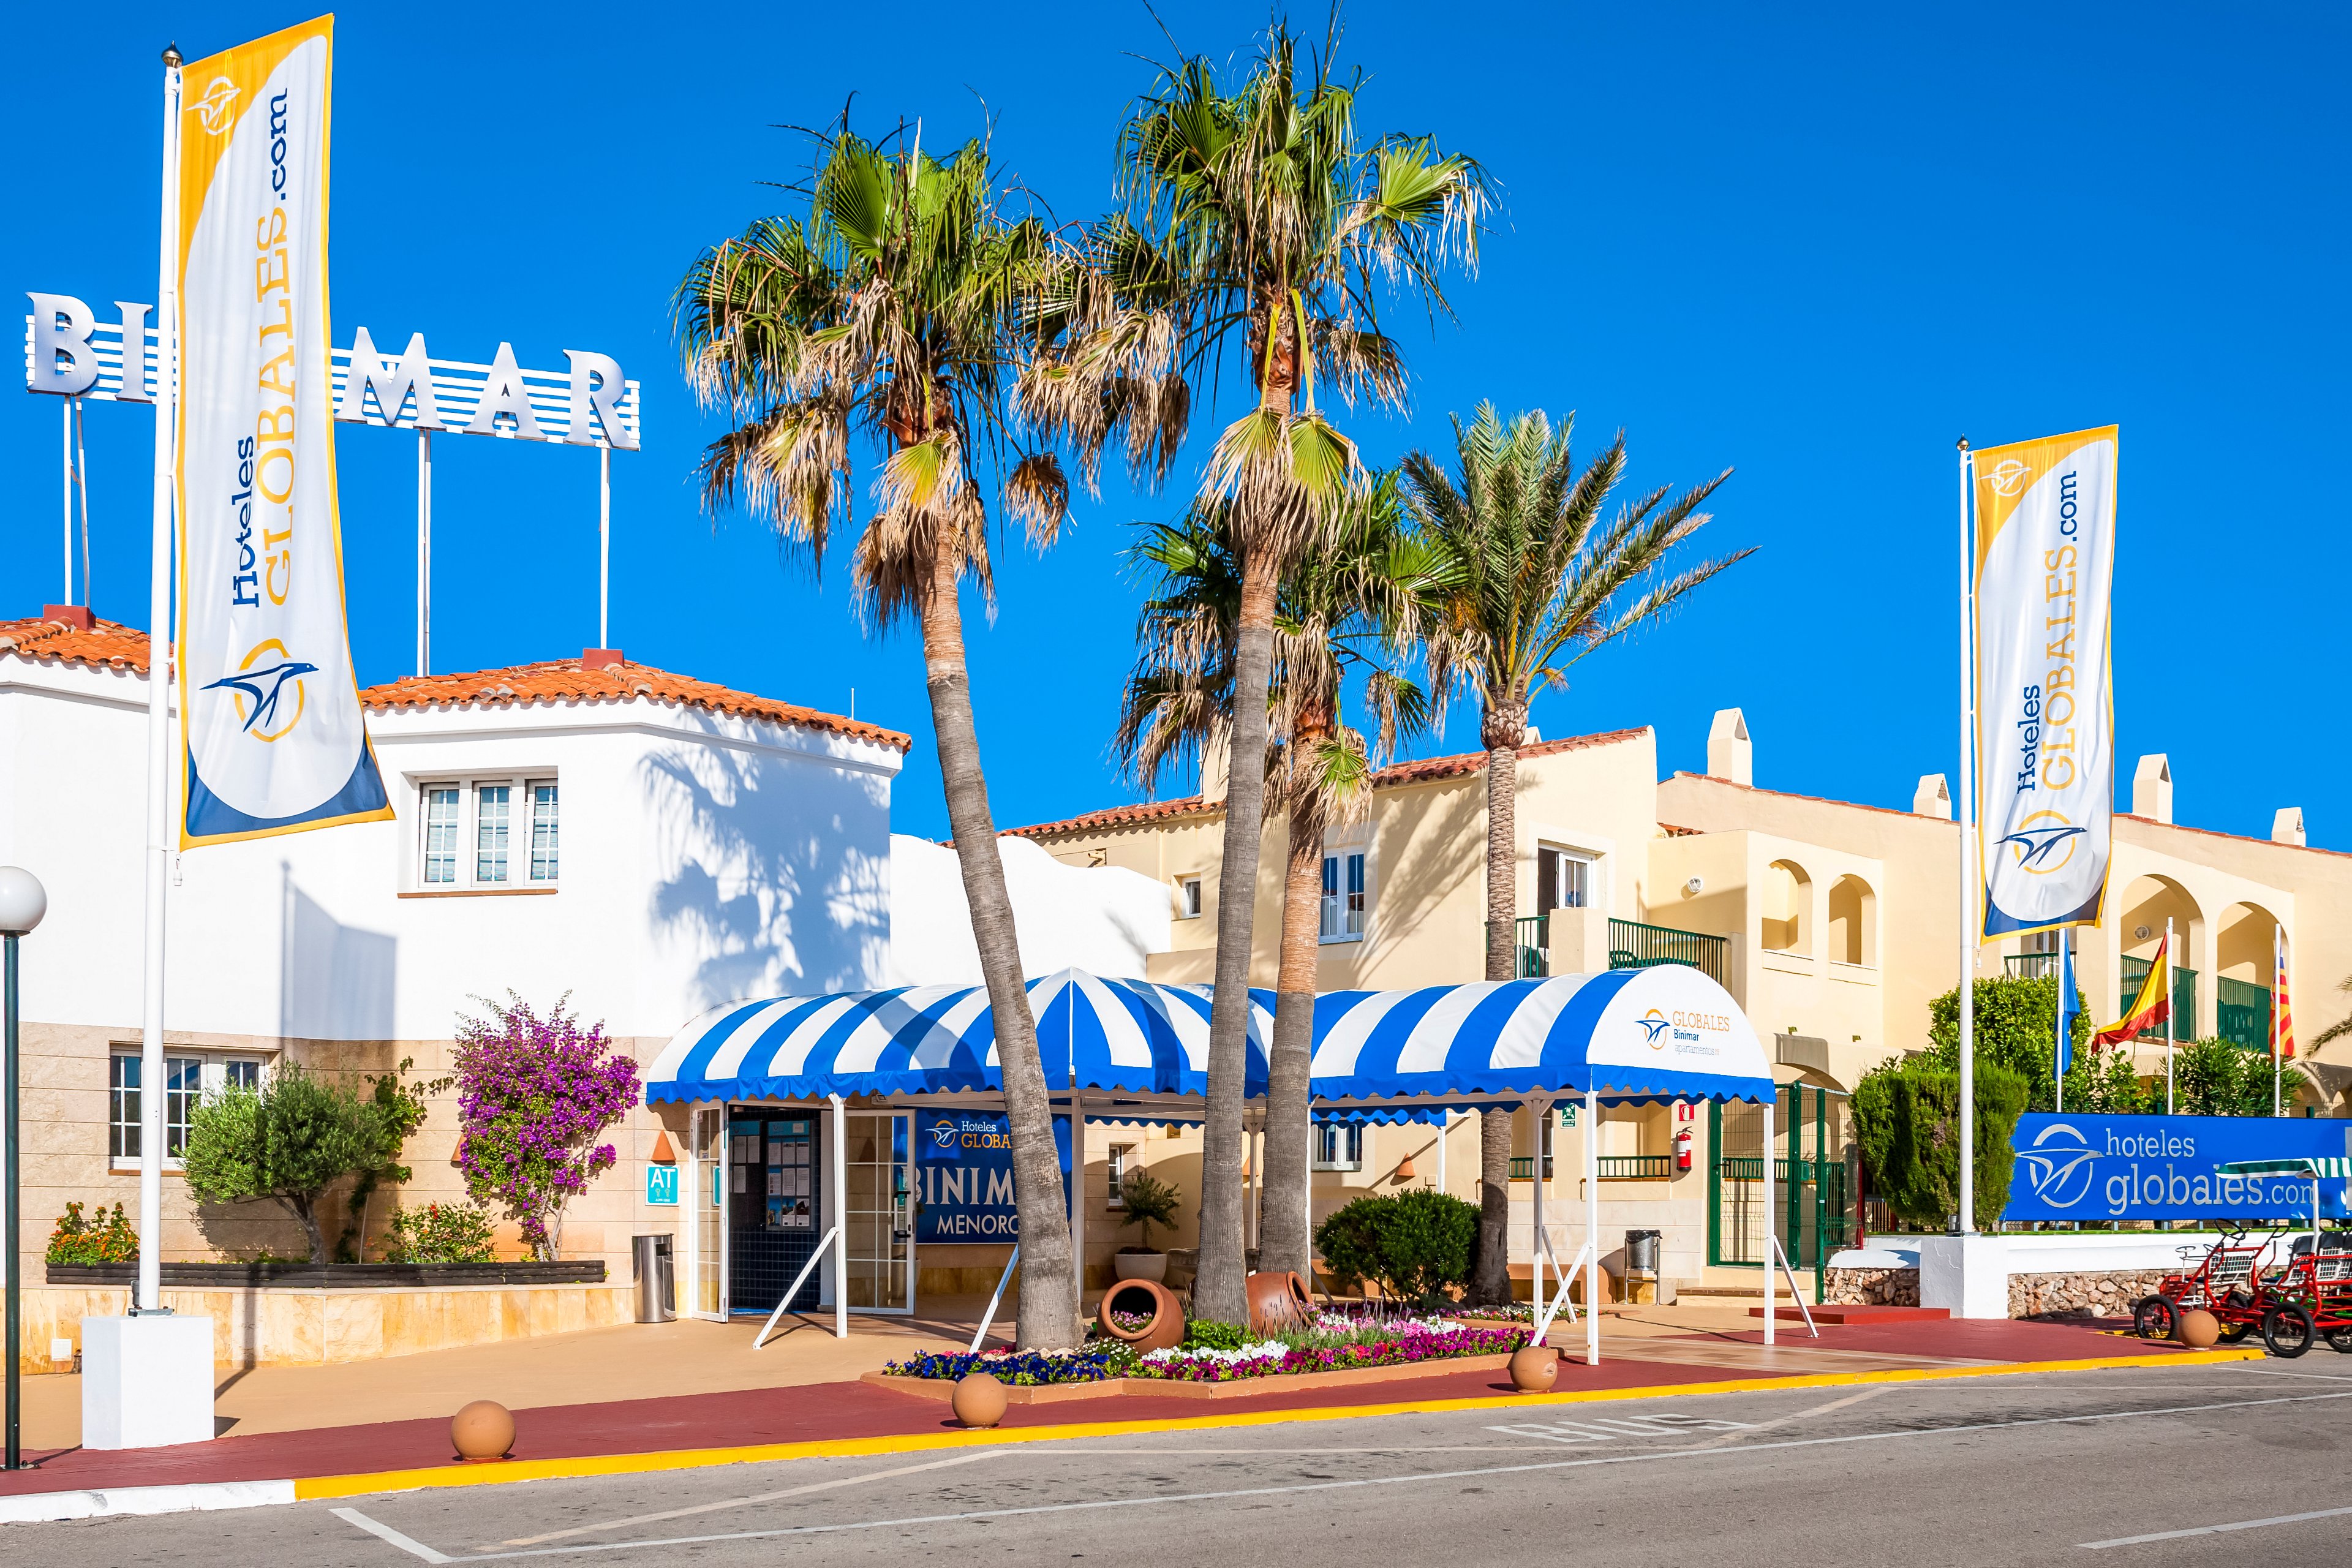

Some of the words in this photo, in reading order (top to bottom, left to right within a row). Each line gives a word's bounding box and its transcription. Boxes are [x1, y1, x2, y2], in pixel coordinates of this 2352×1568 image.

[256, 88, 296, 606] GLOBALES.com
[26, 291, 641, 452] BIMAR
[232, 435, 260, 608] Hoteles
[2041, 470, 2078, 790] GLOBALES.com
[2016, 685, 2040, 794] Hoteles
[1673, 1011, 1730, 1031] GLOBALES
[1674, 1029, 1699, 1041] Binimar
[1675, 1044, 1714, 1055] apartamentos
[961, 1121, 997, 1132] Hoteles
[961, 1133, 1012, 1149] GLOBA
[2106, 1128, 2195, 1158] hoteles
[650, 1168, 676, 1188] AT
[937, 1215, 1019, 1235] MENORC
[1480, 1413, 1760, 1442] BUS
